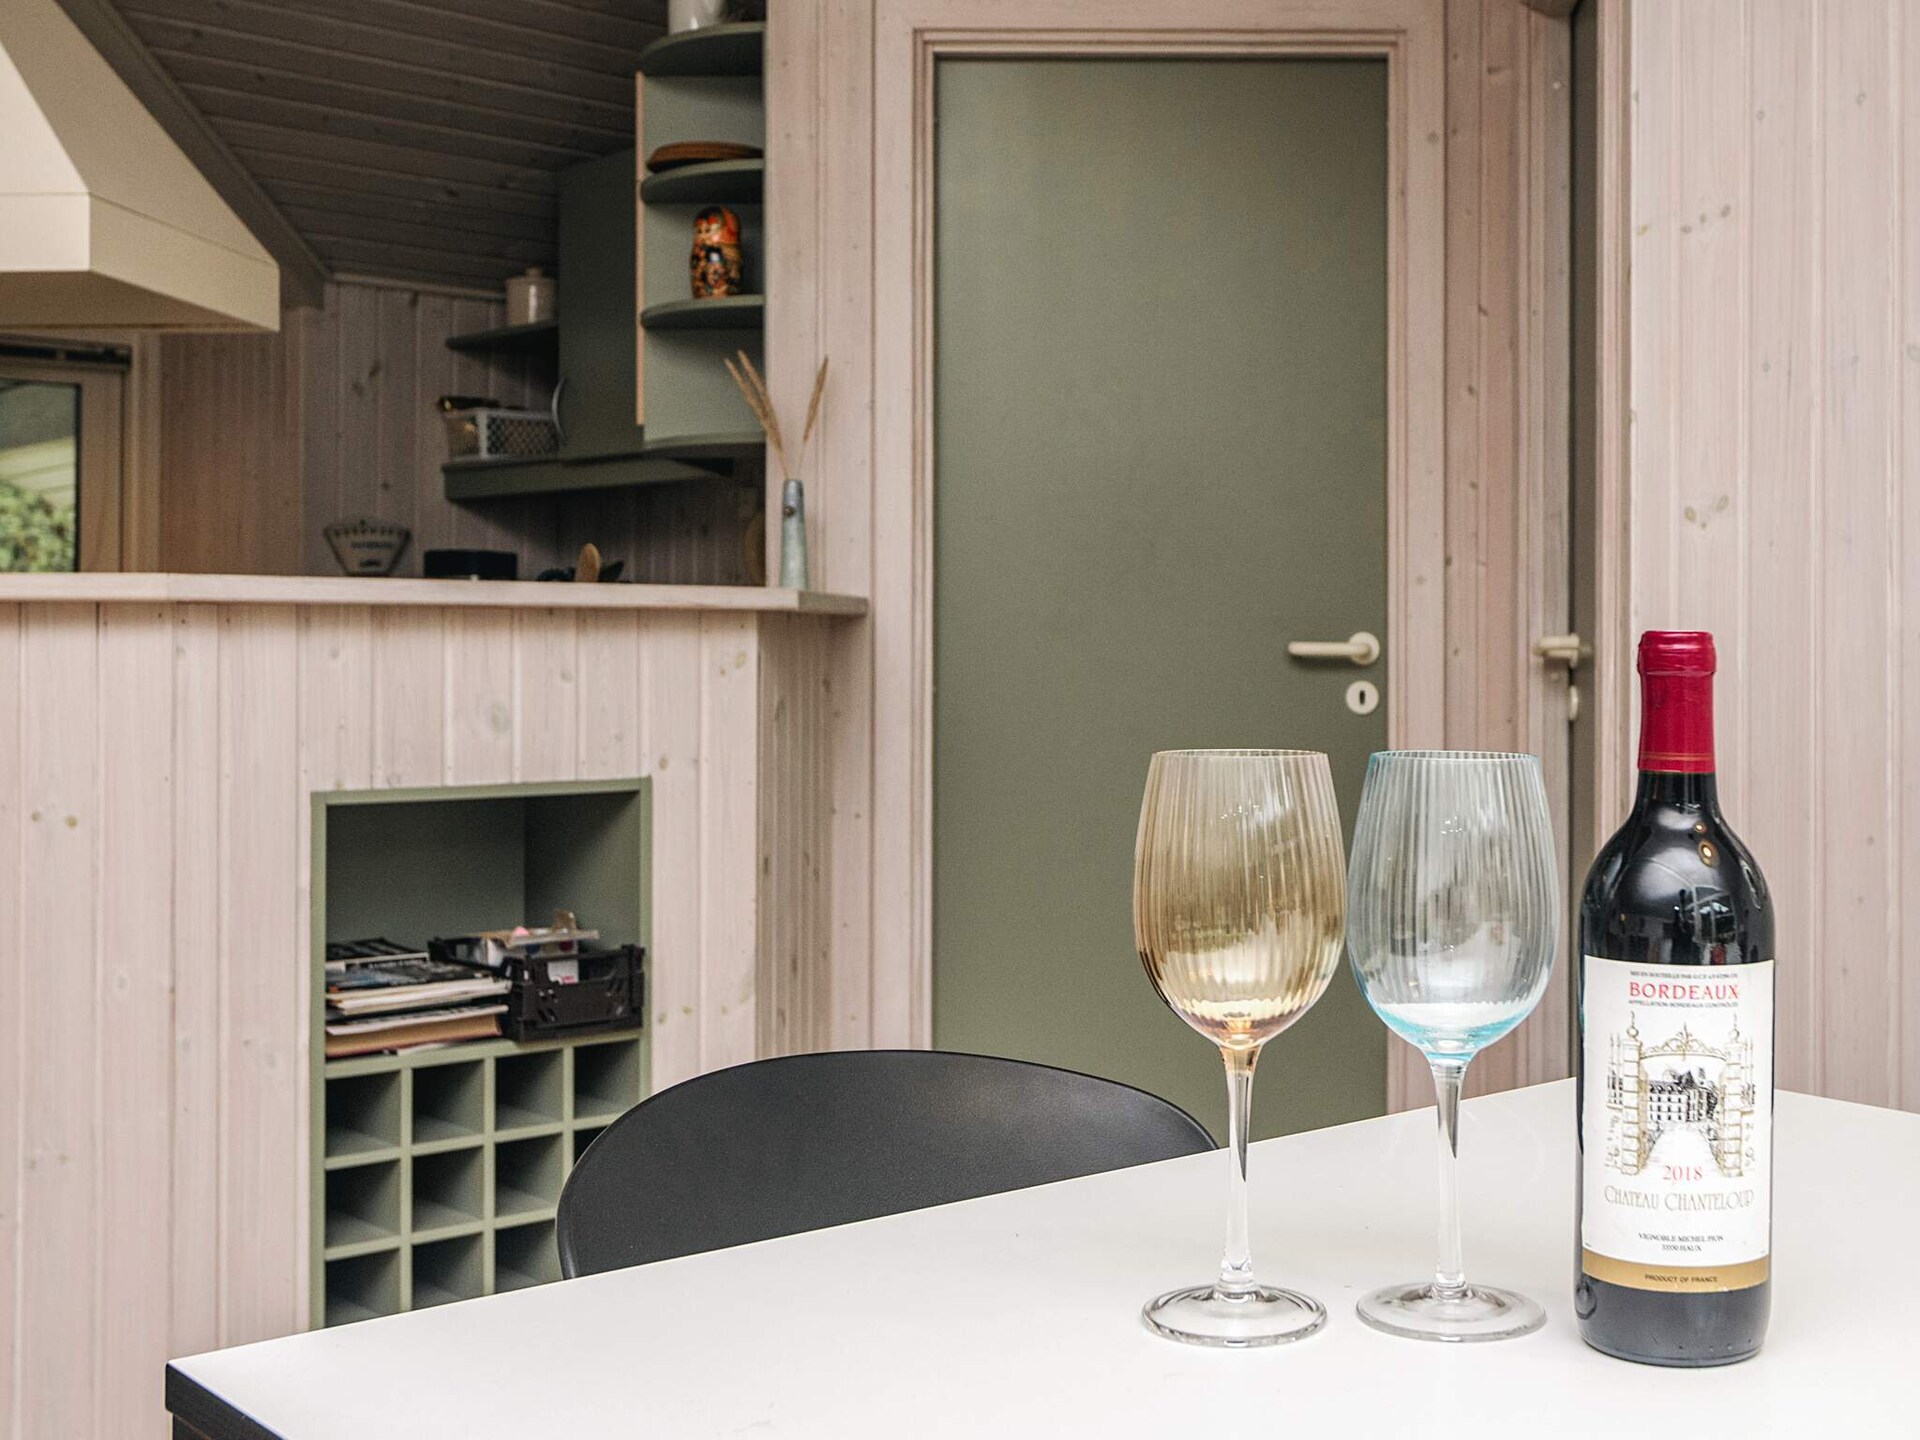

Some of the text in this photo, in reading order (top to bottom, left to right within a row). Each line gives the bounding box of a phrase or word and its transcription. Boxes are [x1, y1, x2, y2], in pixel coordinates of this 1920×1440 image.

[1629, 982, 1739, 1000] BORDEAUX
[1663, 1165, 1703, 1182] 2018
[1604, 1185, 1659, 1210] CHATEAU
[1644, 1274, 1678, 1282] PRODUCT
[1691, 1275, 1718, 1283] FRANCE
